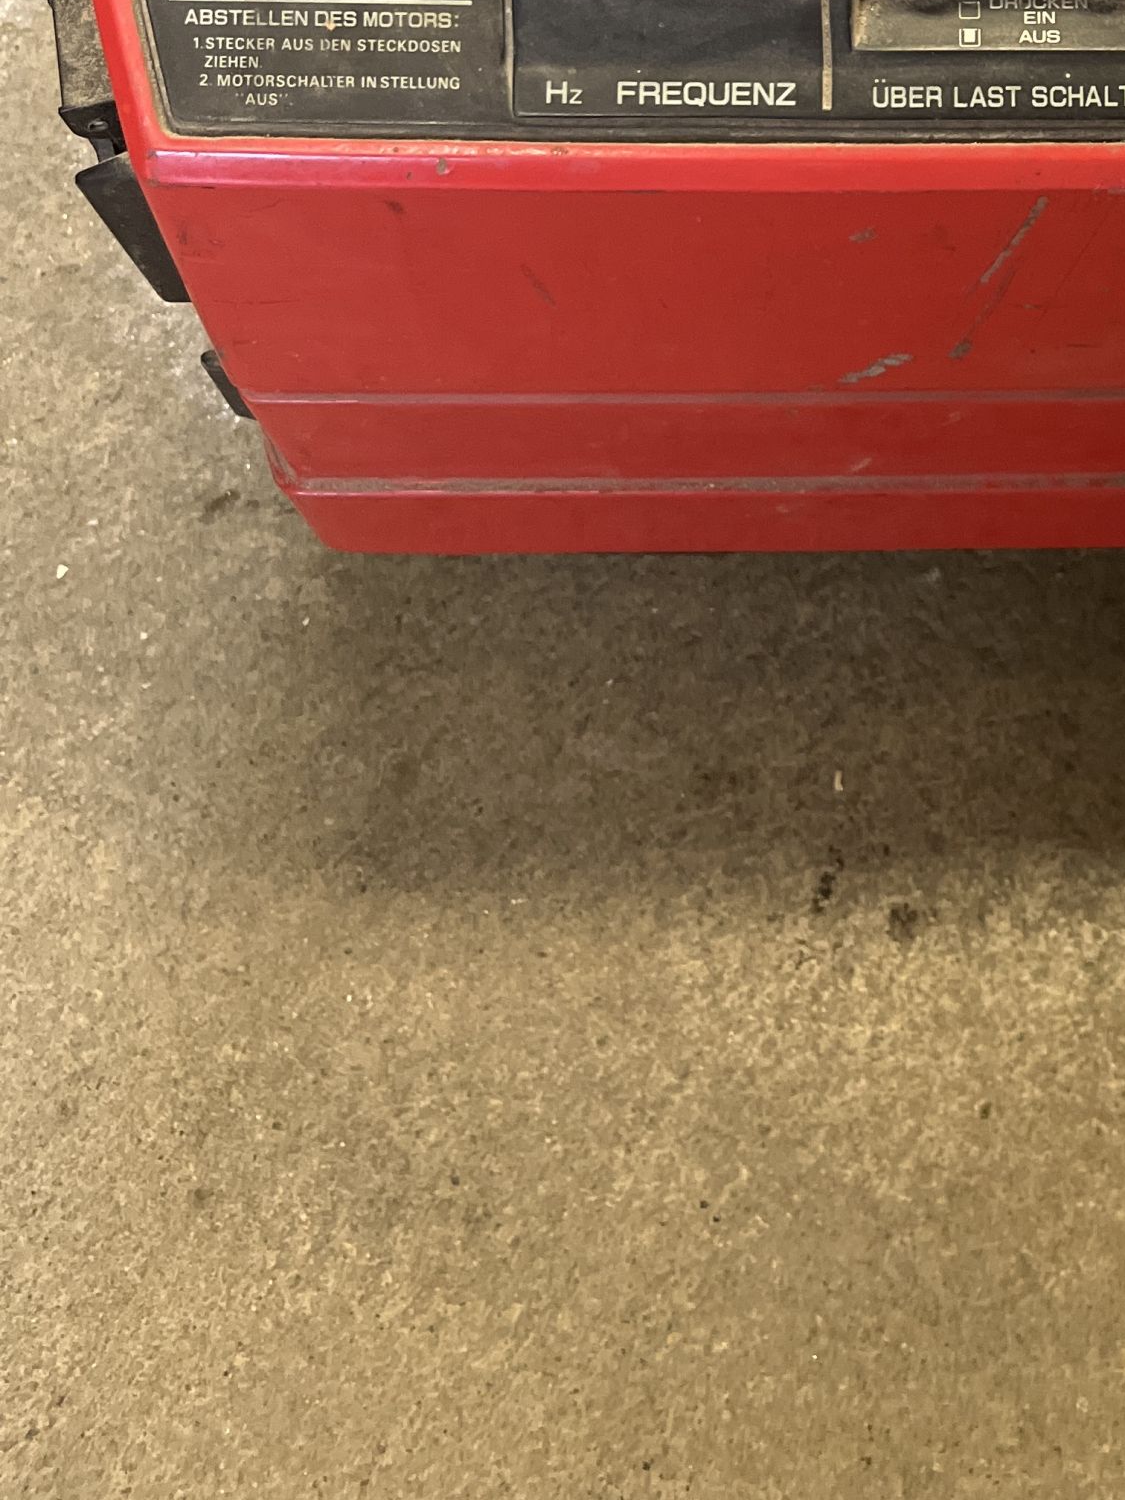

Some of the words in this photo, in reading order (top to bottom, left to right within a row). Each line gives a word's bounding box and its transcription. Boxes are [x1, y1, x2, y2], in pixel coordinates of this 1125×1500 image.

[184, 8, 309, 27] ABSTELLEN
[314, 10, 357, 27] DES
[1023, 11, 1057, 25] EIN
[1018, 29, 1061, 44] AUS
[205, 37, 275, 51] STECKER
[281, 38, 314, 51] AUS
[320, 39, 351, 52] DEN
[357, 39, 462, 53] STECKDOSEN
[199, 73, 213, 87] 2.
[217, 74, 355, 88] MOTORSCHALTER
[545, 81, 583, 105] Hz
[615, 80, 797, 107] FREQUENZ
[872, 78, 943, 109] ÜBER
[953, 85, 1022, 109] LAST
